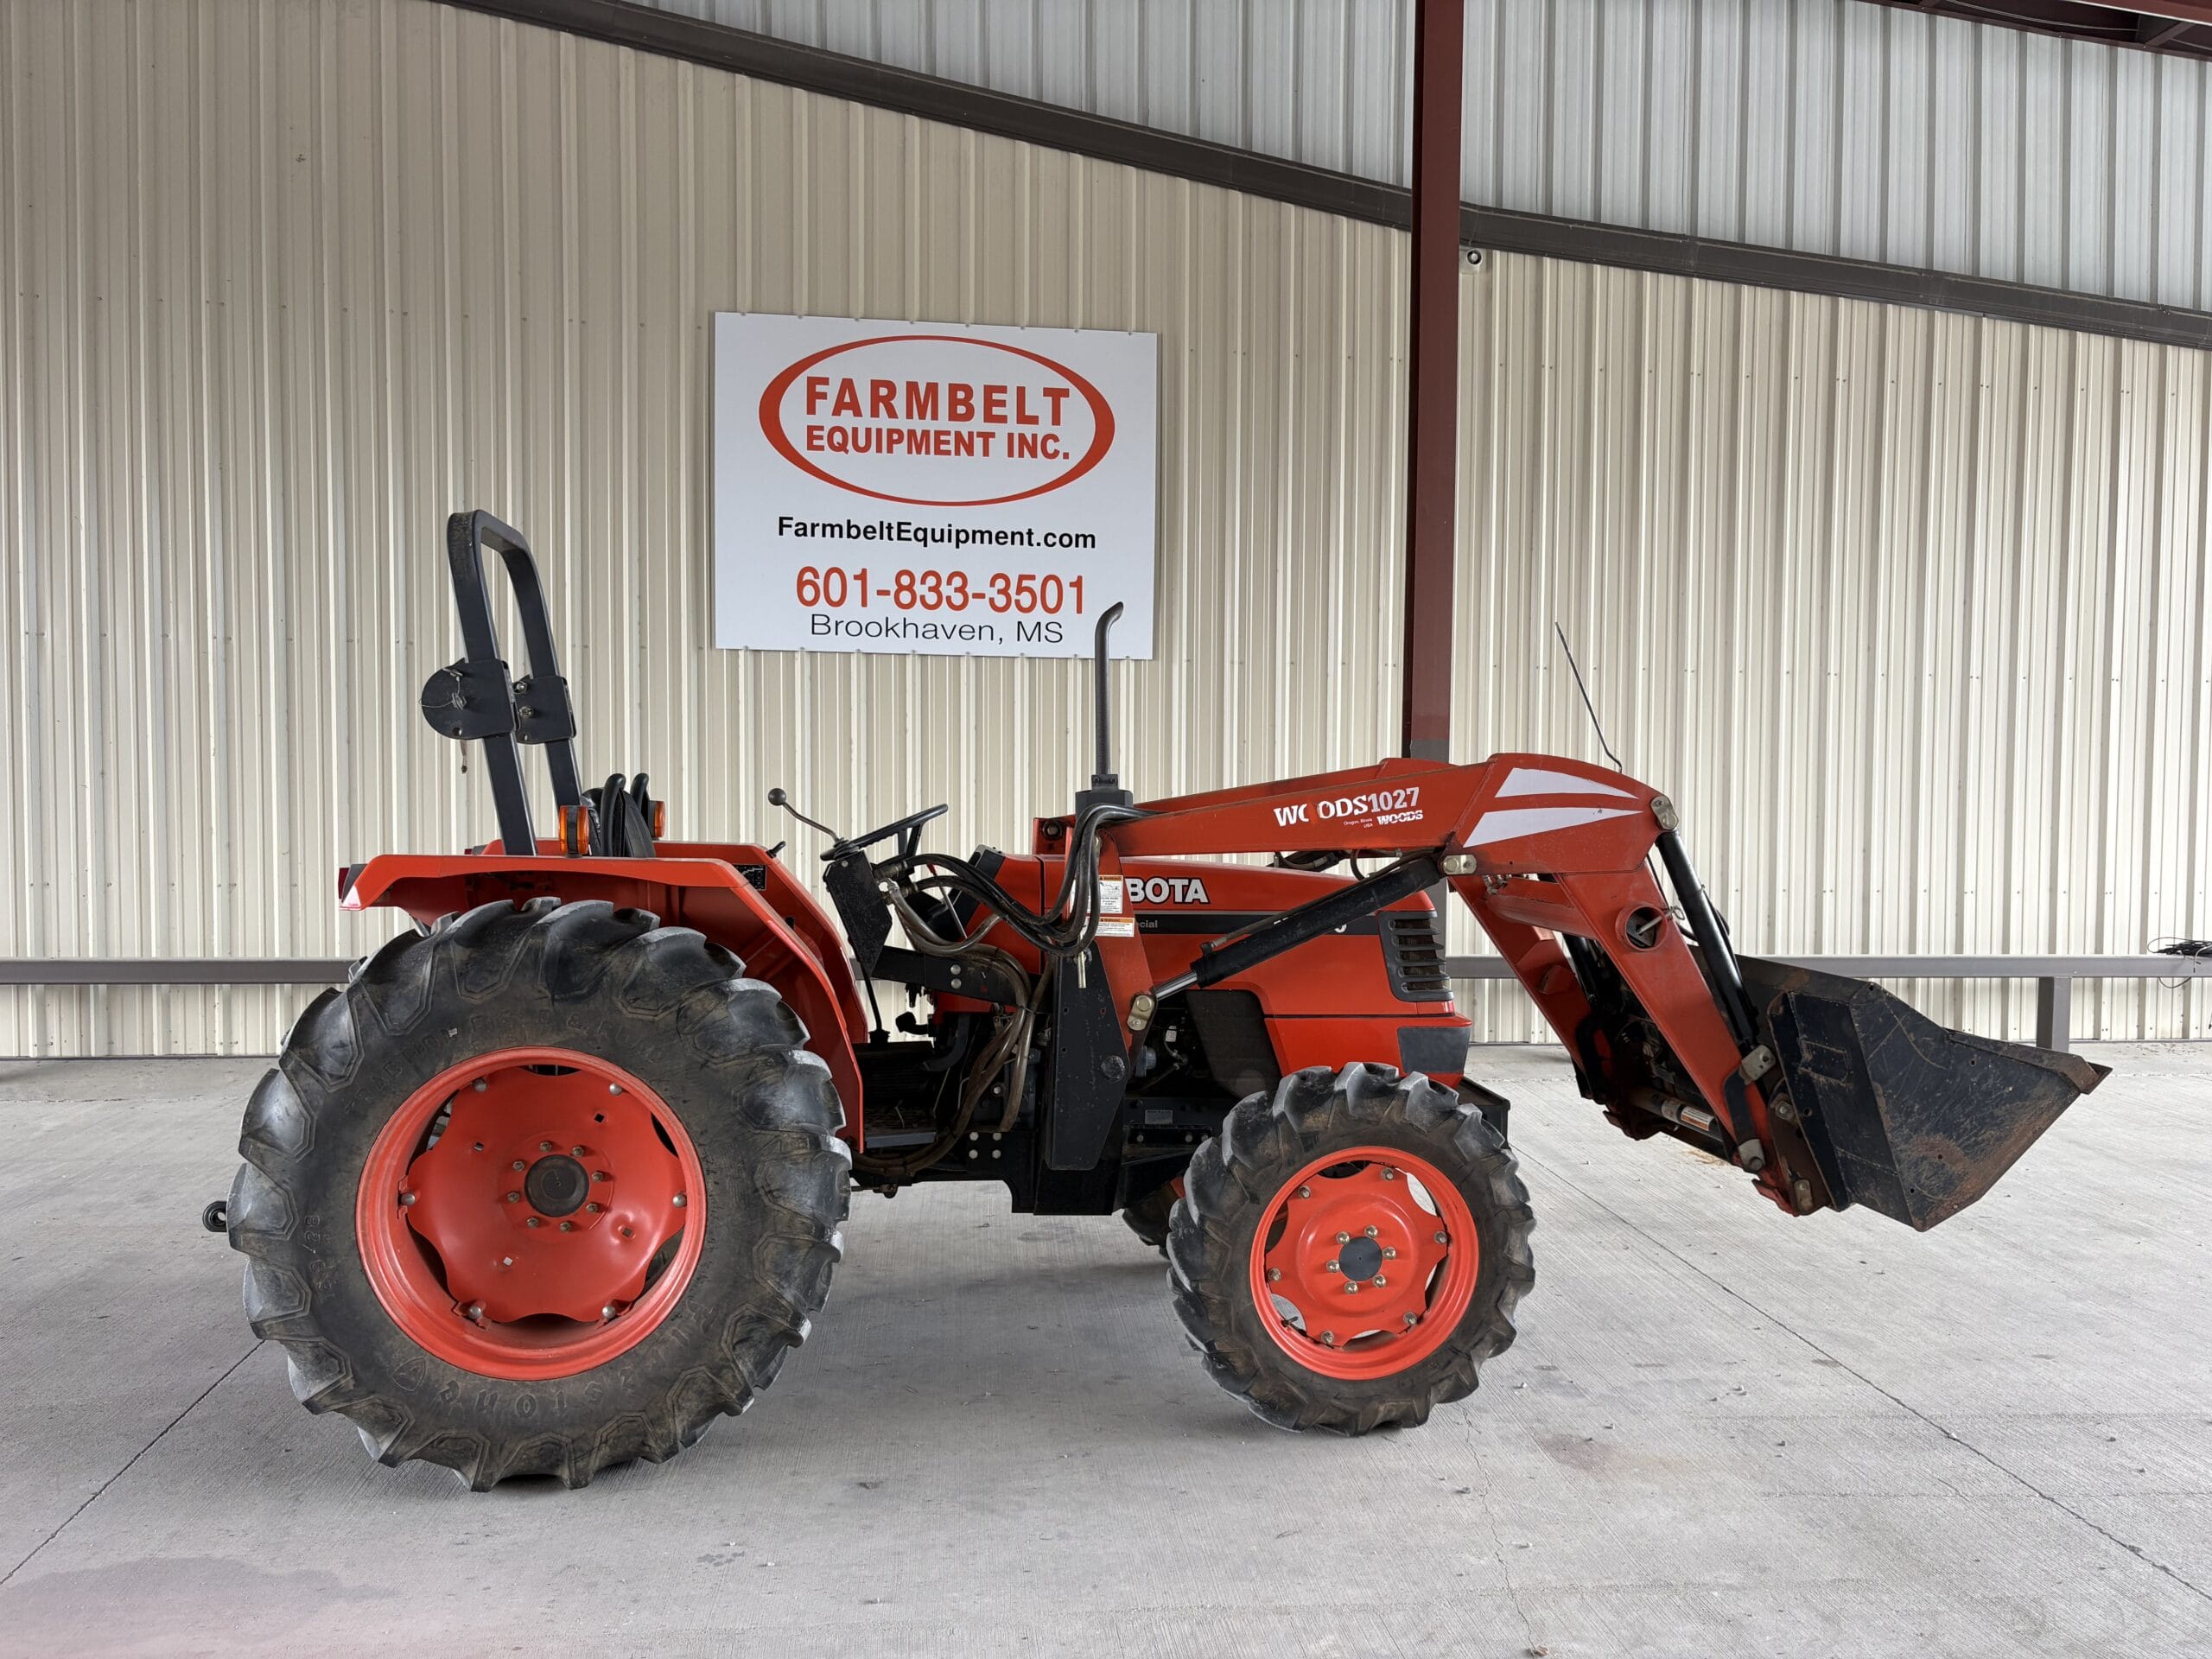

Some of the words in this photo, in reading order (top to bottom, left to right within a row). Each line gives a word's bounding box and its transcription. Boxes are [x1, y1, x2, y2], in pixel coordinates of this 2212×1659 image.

[805, 376, 1071, 426] FARMBELT
[805, 424, 996, 458] EQUIPMENT
[1007, 432, 1071, 460] INC.
[778, 516, 1096, 550] FarmbeltEquipment.com
[796, 566, 1084, 615] 601-833-3501
[810, 613, 1004, 645] Brookhaven,
[1016, 620, 1064, 644] MS
[1376, 809, 1424, 826] WOODS
[1124, 877, 1210, 904] BOTA
[1138, 919, 1159, 929] cial
